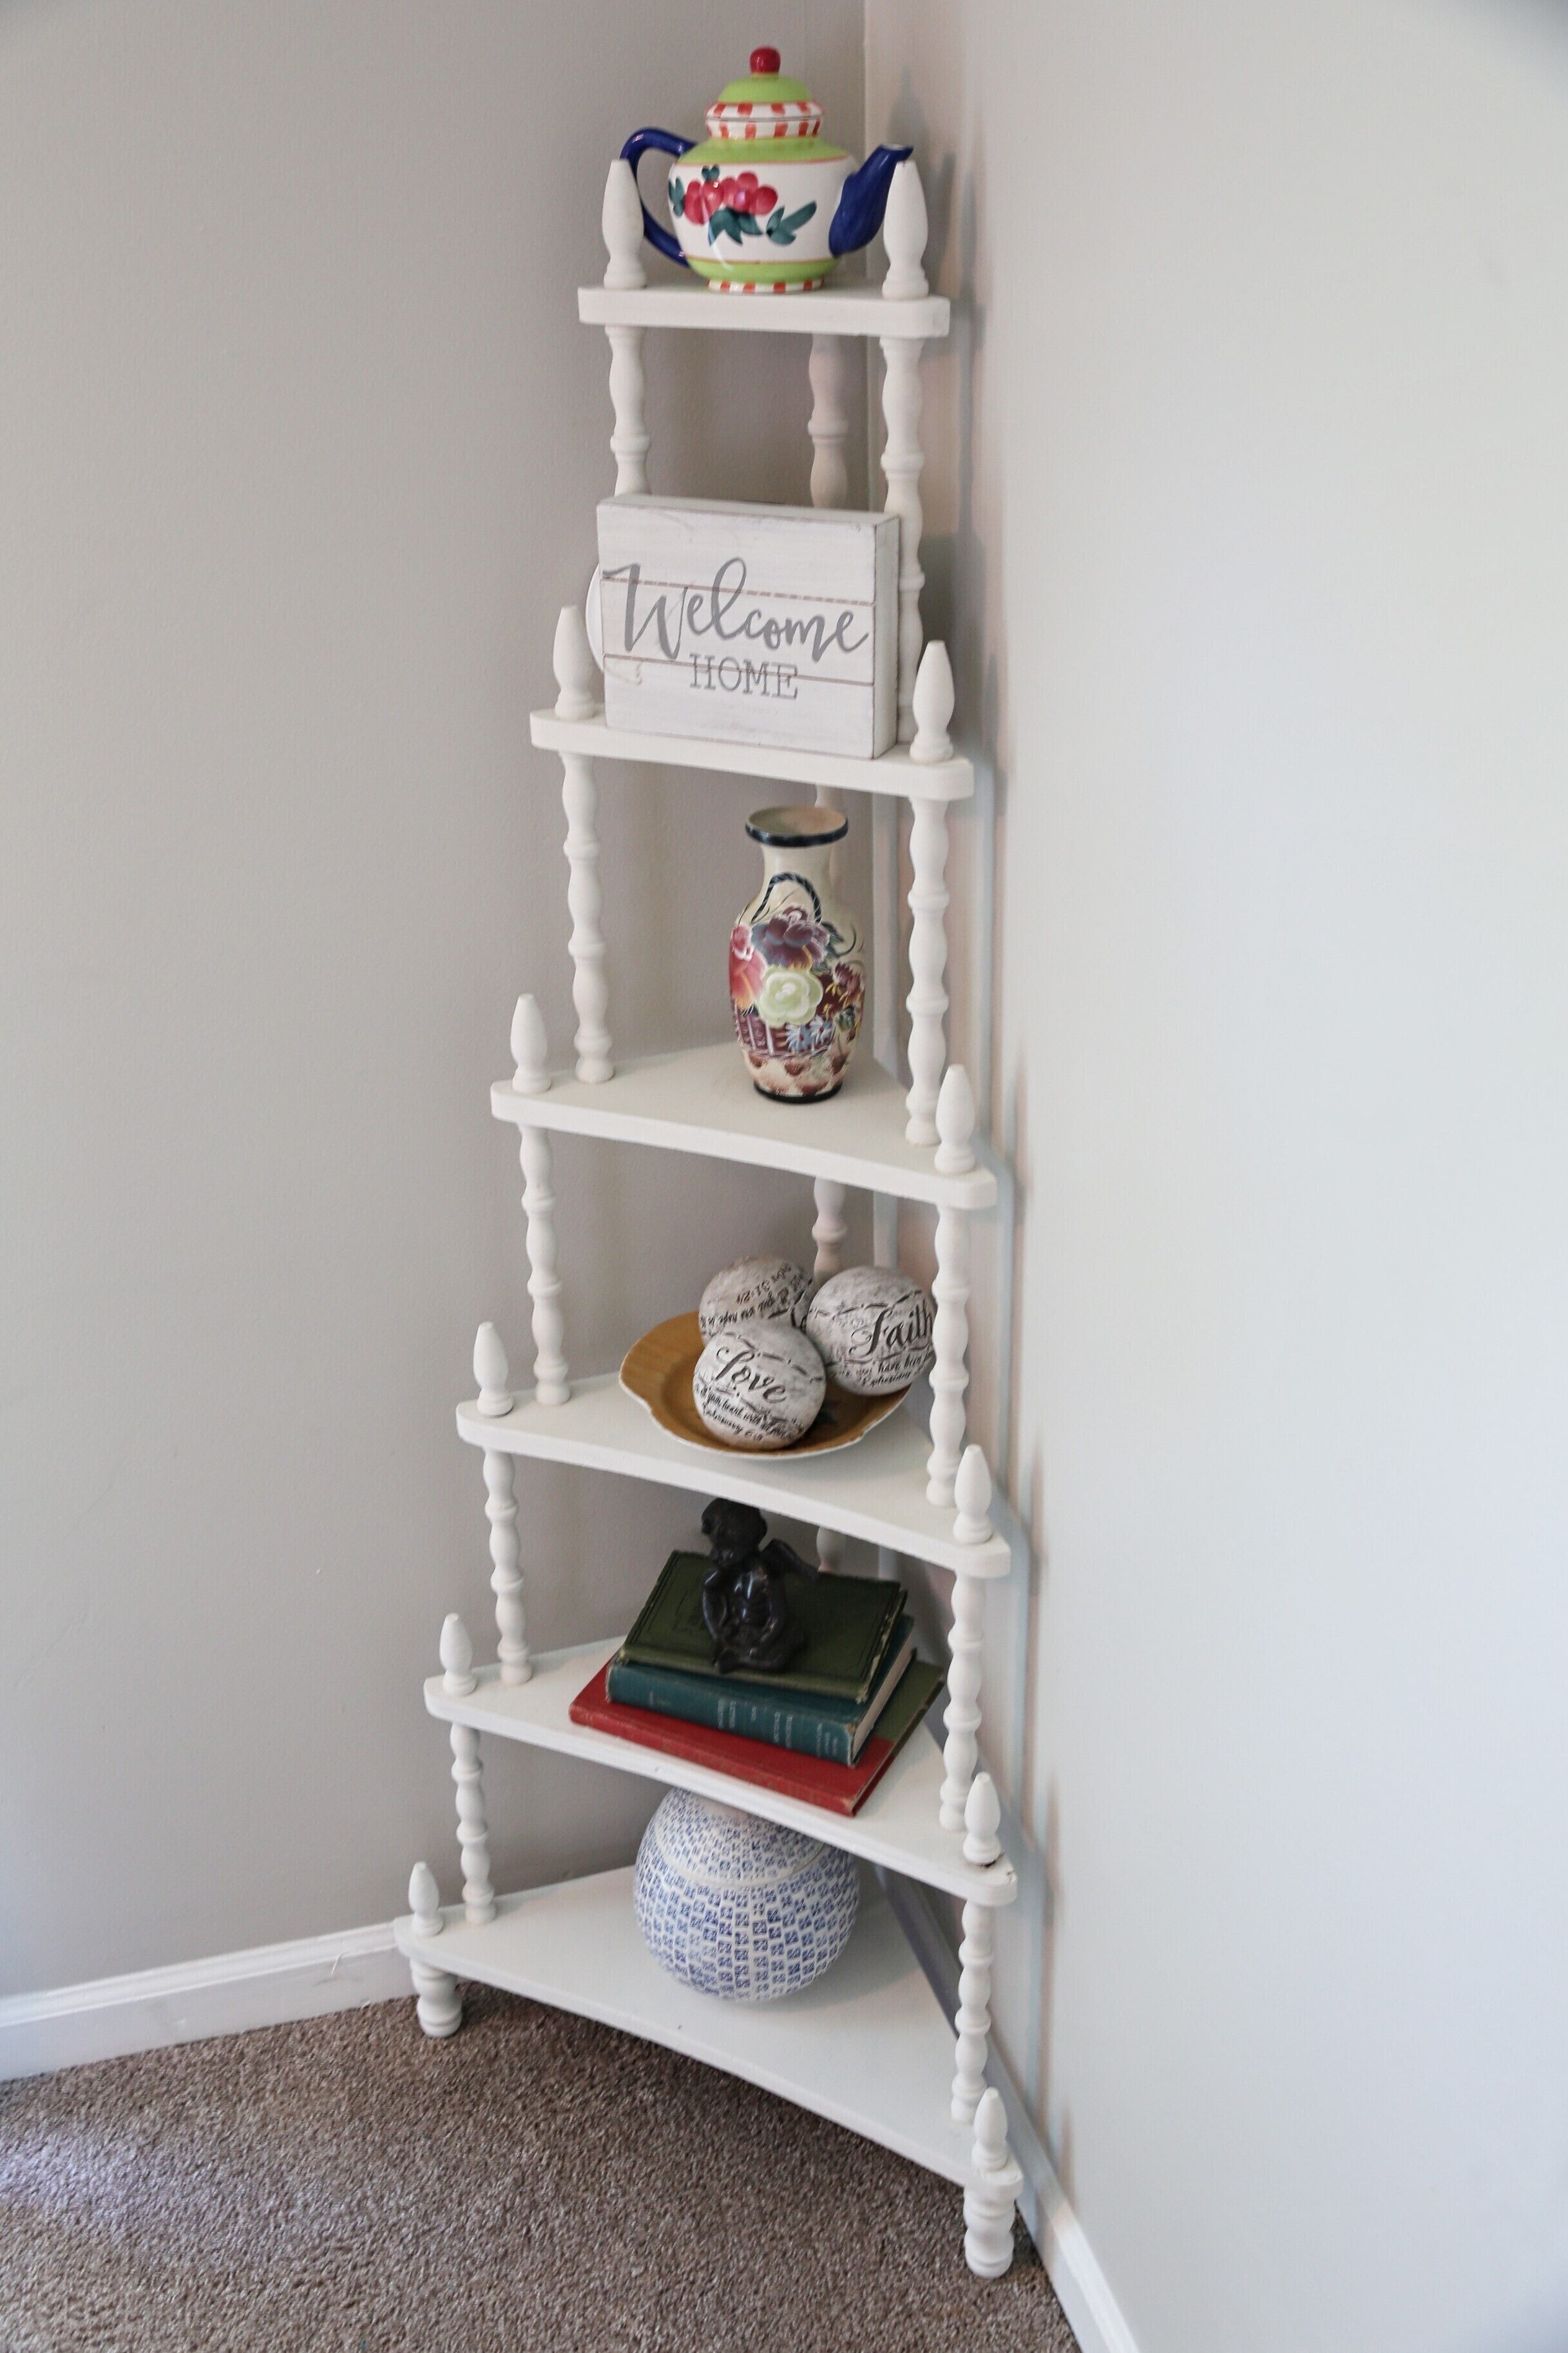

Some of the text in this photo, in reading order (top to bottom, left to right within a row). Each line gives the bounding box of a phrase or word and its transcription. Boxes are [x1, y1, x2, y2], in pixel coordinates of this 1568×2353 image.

[602, 557, 869, 662] Welcome
[689, 652, 799, 700] HOME
[848, 1298, 933, 1356] Faith
[716, 1347, 787, 1404] Love
